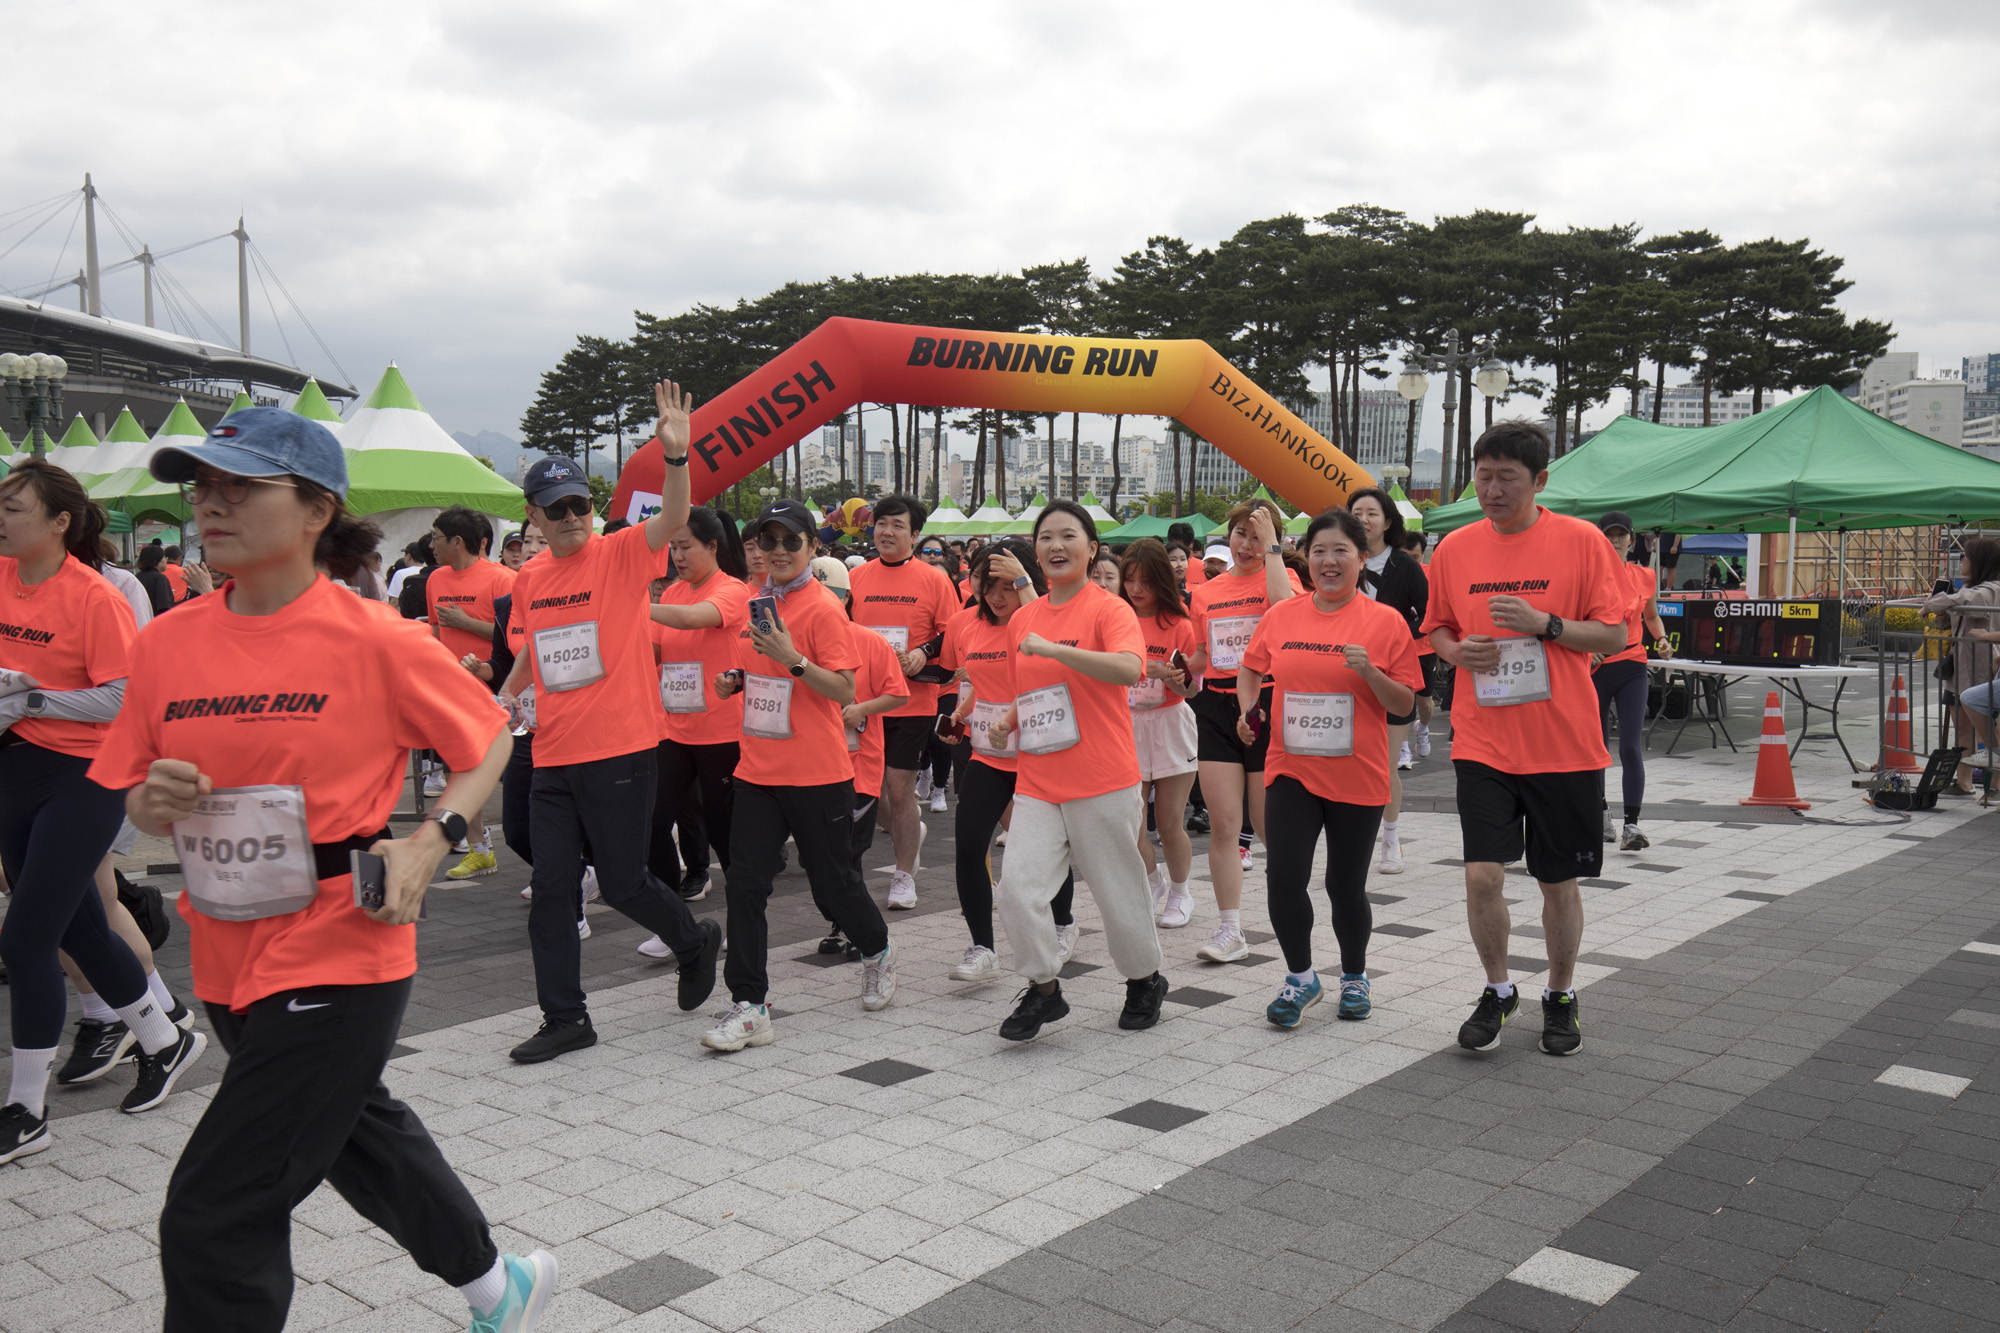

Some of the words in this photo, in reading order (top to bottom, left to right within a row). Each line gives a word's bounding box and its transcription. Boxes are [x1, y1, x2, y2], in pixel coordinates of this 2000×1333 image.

[907, 336, 1076, 375] BURNING
[1082, 347, 1159, 377] RUN
[1035, 375, 1069, 386] Casual
[692, 360, 836, 473] FINISH
[1469, 580, 1521, 595] BURNING
[1520, 580, 1550, 591] RUN
[437, 595, 463, 603] BURNING
[461, 595, 477, 603] RUN
[530, 595, 569, 611] BURNING
[568, 590, 592, 605] RUN
[864, 595, 900, 603] BURNING
[898, 596, 918, 604] RUN
[1206, 598, 1246, 613] BURNING
[1244, 596, 1265, 605] RUN
[1658, 604, 1678, 616] 7km
[1788, 605, 1812, 616] 5km
[20, 627, 56, 644] RUN
[1216, 638, 1224, 646] W
[1281, 641, 1333, 653] BURNING
[543, 654, 551, 664] M
[553, 645, 590, 664] 5023
[1147, 645, 1168, 655] RUN
[1212, 656, 1234, 665] D-355
[669, 680, 697, 691] 6204
[1482, 688, 1501, 696] A-752
[163, 693, 270, 723] BURNING
[268, 692, 330, 714] RUN
[747, 697, 753, 706] W
[753, 697, 783, 714] 6381
[973, 720, 979, 729] W
[1021, 718, 1029, 729] W
[1029, 708, 1065, 729] 6279
[1287, 715, 1297, 725] W
[1299, 715, 1344, 730] 6293
[261, 800, 289, 809] 5km
[182, 834, 198, 853] W
[201, 833, 287, 865] 6005
